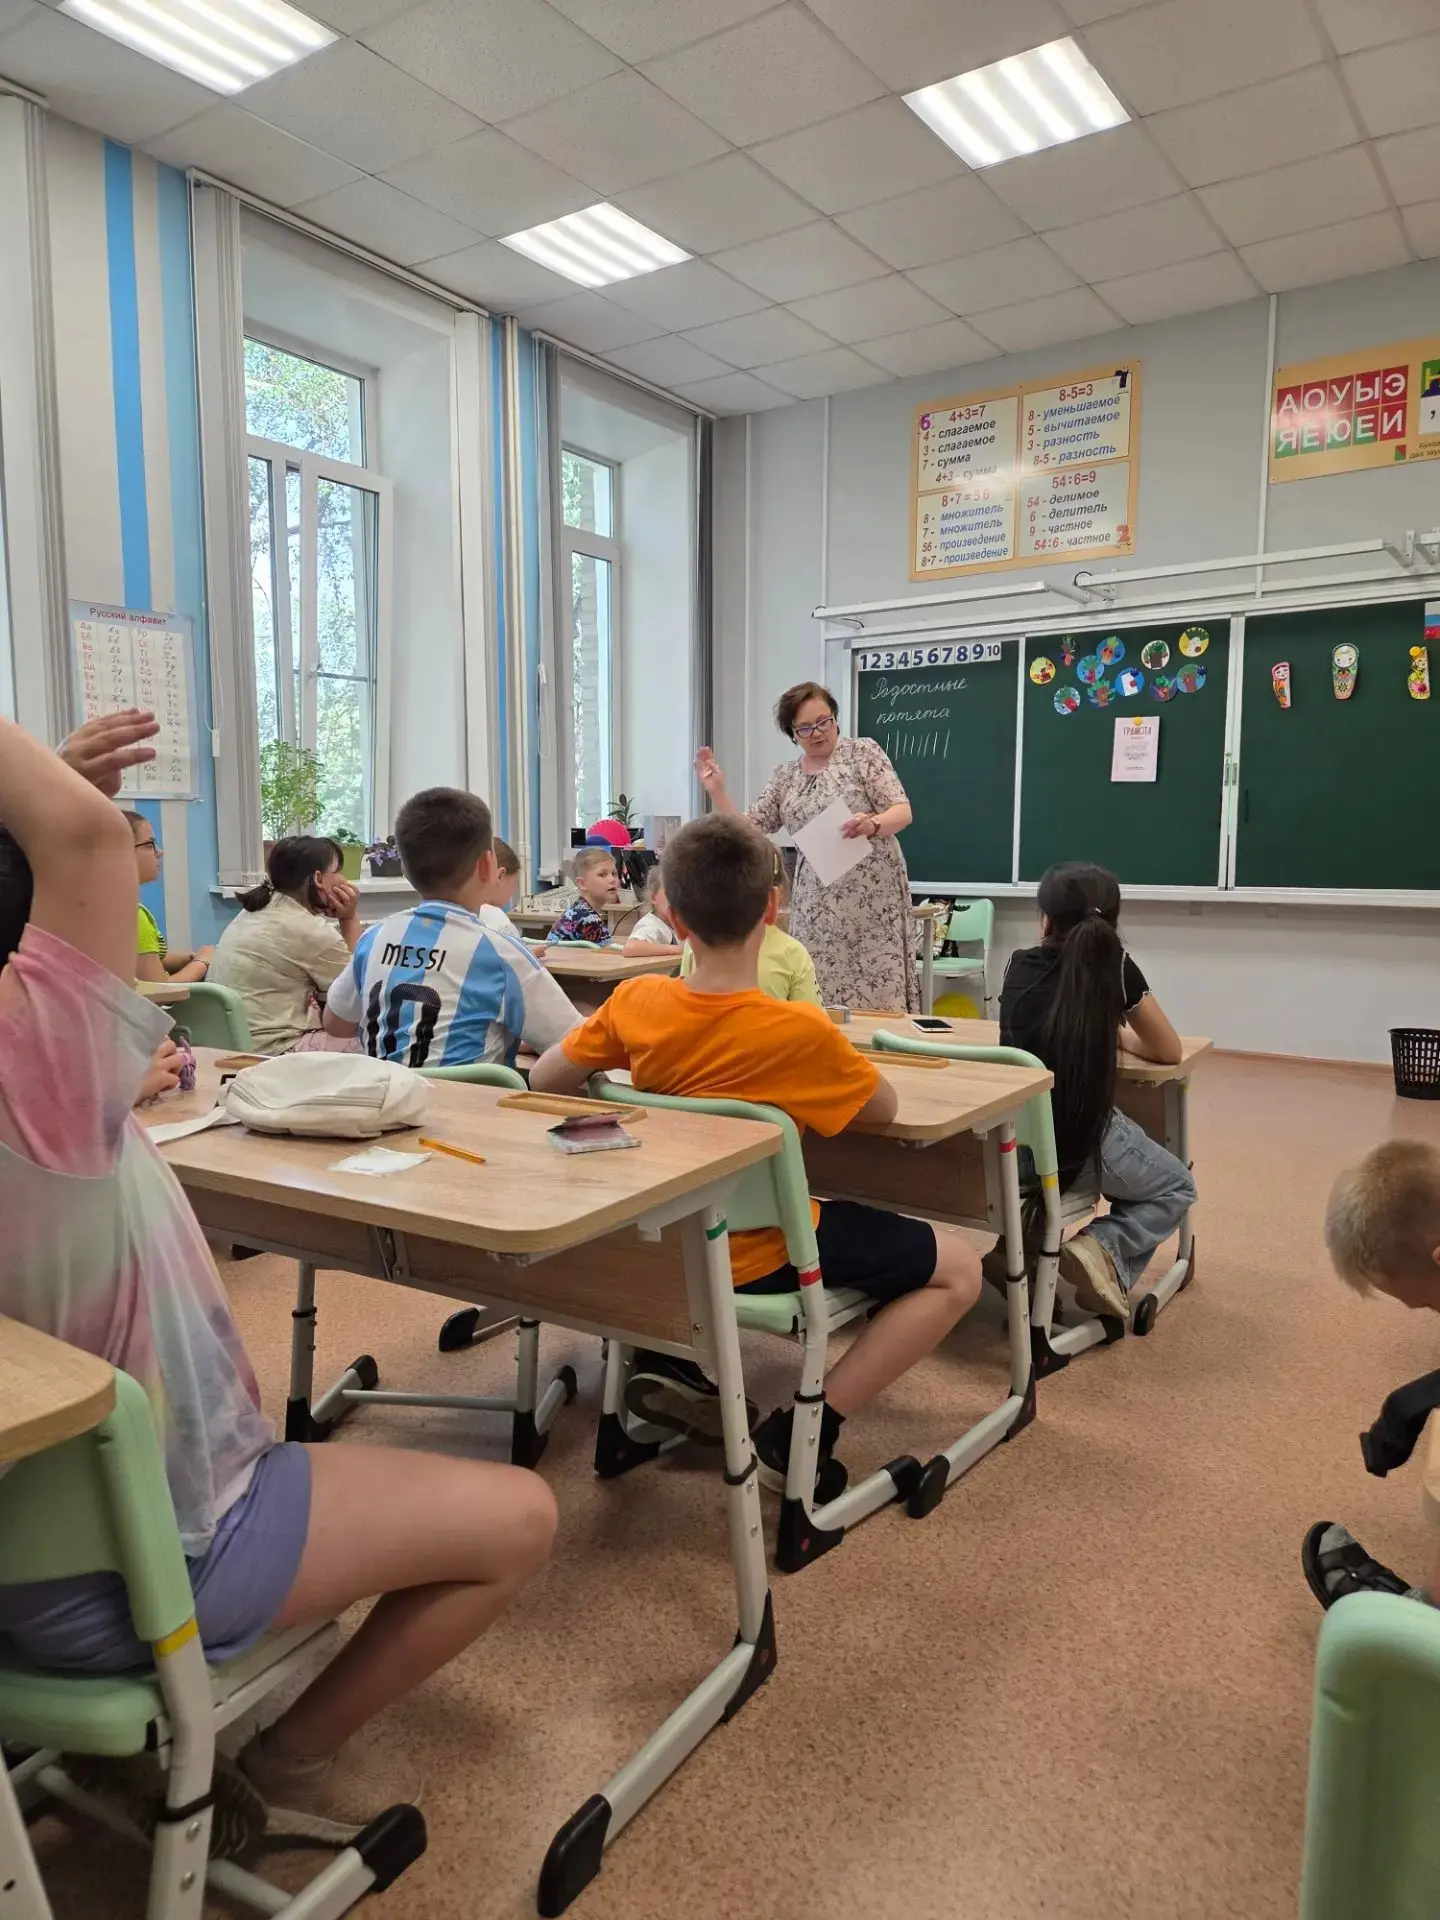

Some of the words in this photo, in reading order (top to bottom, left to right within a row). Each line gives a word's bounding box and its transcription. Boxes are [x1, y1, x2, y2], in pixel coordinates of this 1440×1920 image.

[1059, 383, 1093, 401] 8-5=3
[949, 405, 986, 423] 4+3=7
[1028, 410, 1035, 421] 8
[1043, 396, 1120, 421] уменьшаемое
[938, 420, 996, 439] слагаемое
[1028, 425, 1035, 436] 5
[1044, 411, 1120, 433] вычитаемое
[938, 435, 996, 453] слагаемое
[1027, 440, 1034, 450] 3
[1043, 431, 1100, 450] разность
[923, 459, 929, 470] 7
[937, 453, 972, 469] сумма
[1059, 444, 1116, 464] разность
[1049, 490, 1100, 505] делимое
[940, 504, 1004, 522] множитель
[1049, 503, 1108, 519] делитель
[922, 528, 929, 538] 7
[940, 518, 1003, 536] множитель
[1048, 519, 1093, 534] частное
[940, 533, 1006, 551] произведение
[1067, 532, 1111, 546] частное
[943, 547, 1008, 565] произведение
[89, 607, 126, 620] Русский
[129, 612, 166, 625] алфавит
[871, 677, 969, 706] Радостные
[876, 708, 951, 725] котята
[381, 943, 447, 972] MESSI
[366, 980, 442, 1068] 10
